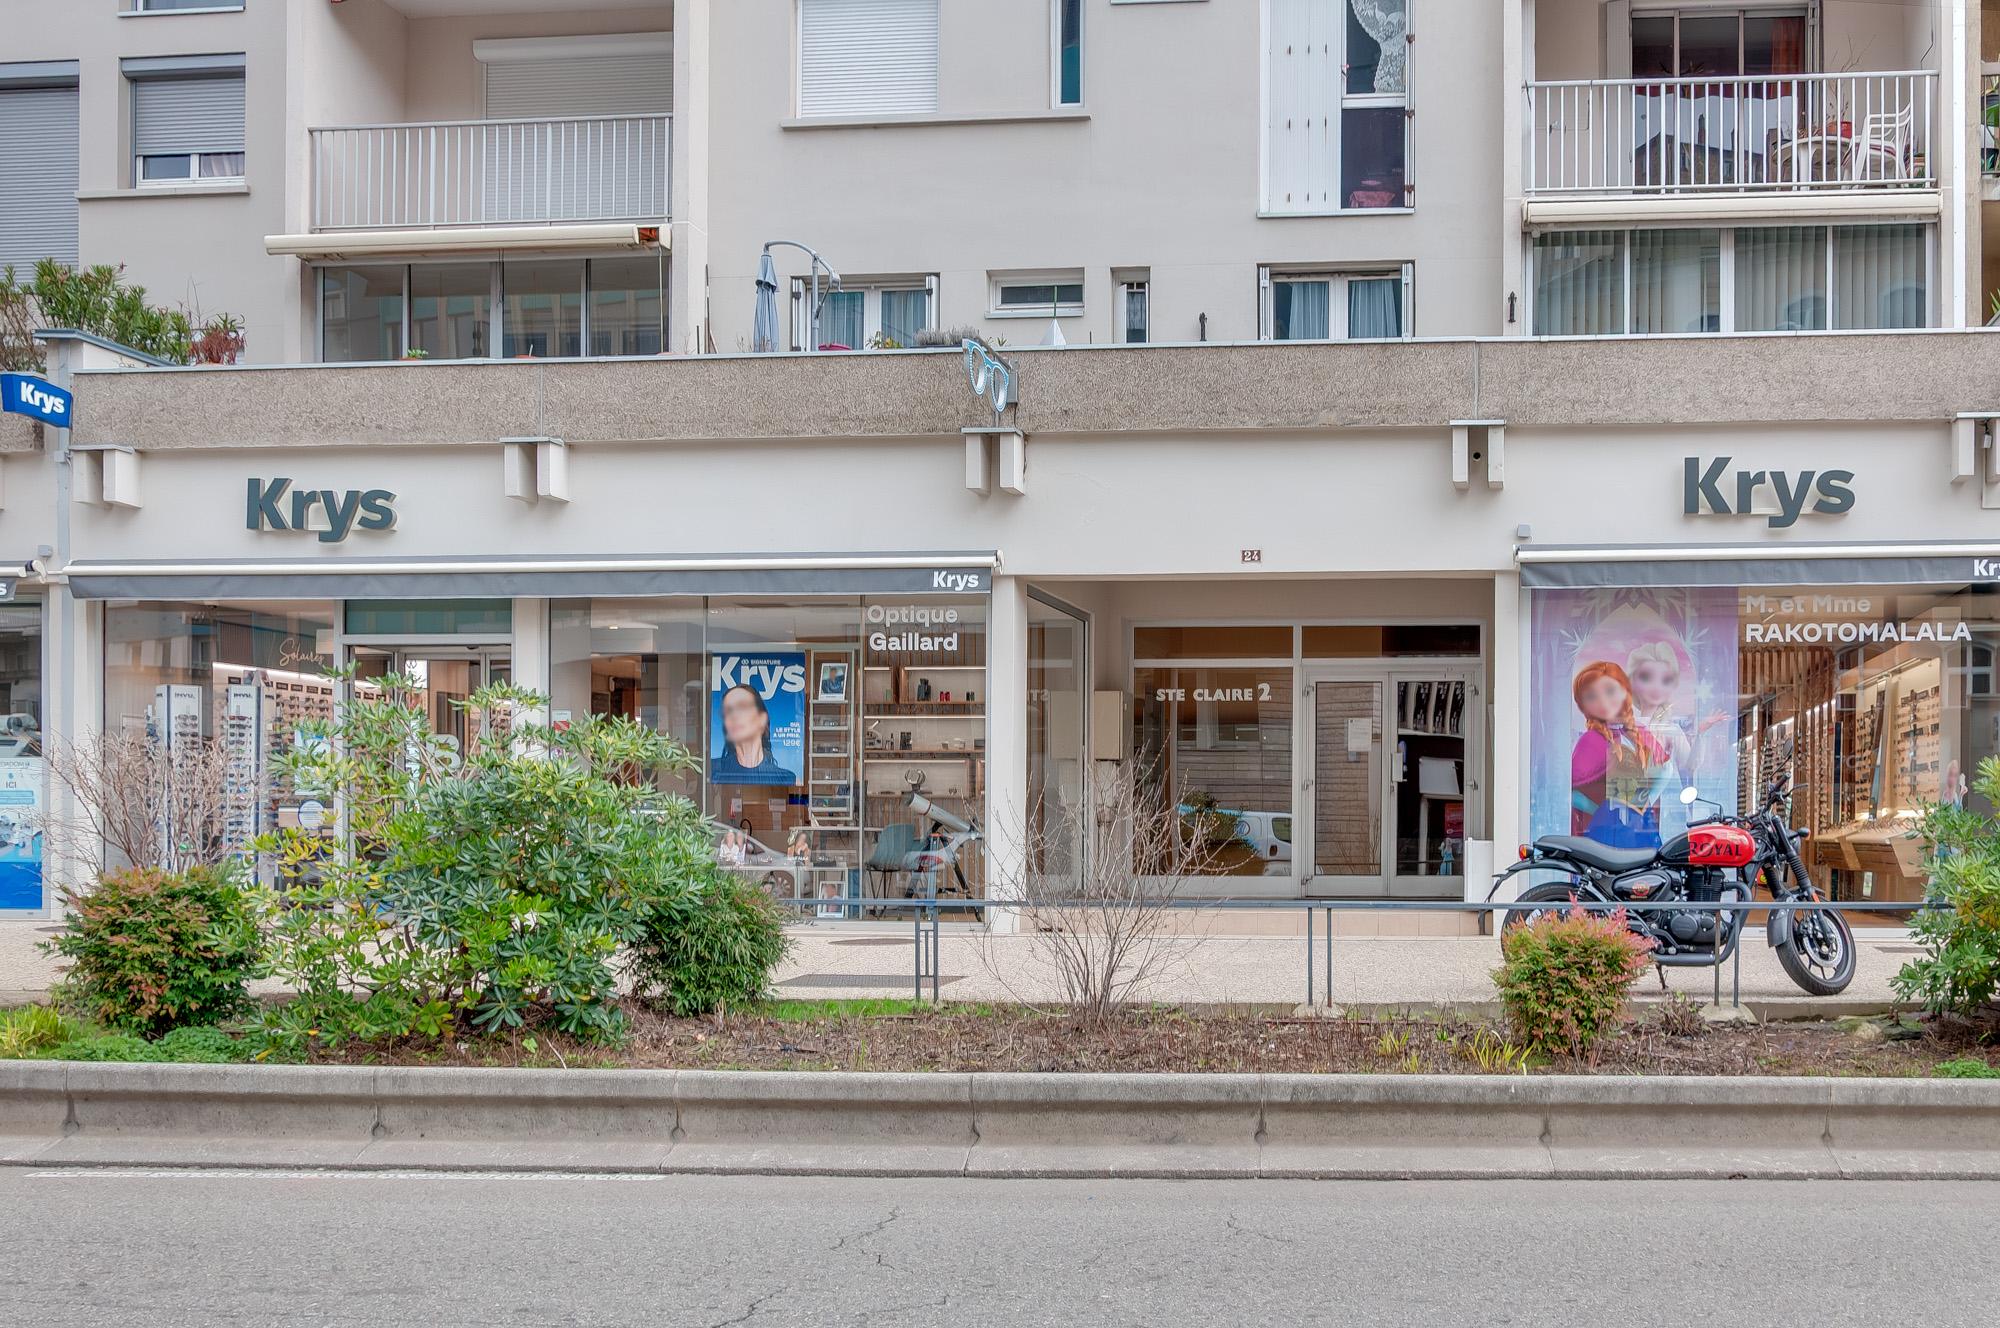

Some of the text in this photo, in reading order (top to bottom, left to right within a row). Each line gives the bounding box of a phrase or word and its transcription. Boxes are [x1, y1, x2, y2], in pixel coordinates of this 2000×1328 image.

[21, 381, 65, 414] Krys
[1684, 457, 1856, 528] Krys
[246, 478, 398, 543] Krys
[1244, 550, 1259, 561] 24
[1973, 559, 2000, 580] Kr
[933, 571, 979, 591] Krys
[1780, 597, 1805, 613] et
[1812, 596, 1871, 613] Mme
[867, 605, 958, 627] Optique
[869, 632, 958, 651] Gaillard
[1745, 622, 1972, 643] RAKOTOMALALA
[712, 656, 805, 700] Krys
[1156, 683, 1272, 702] STE CLAIRE 2
[1689, 841, 1742, 858] ROYAL
